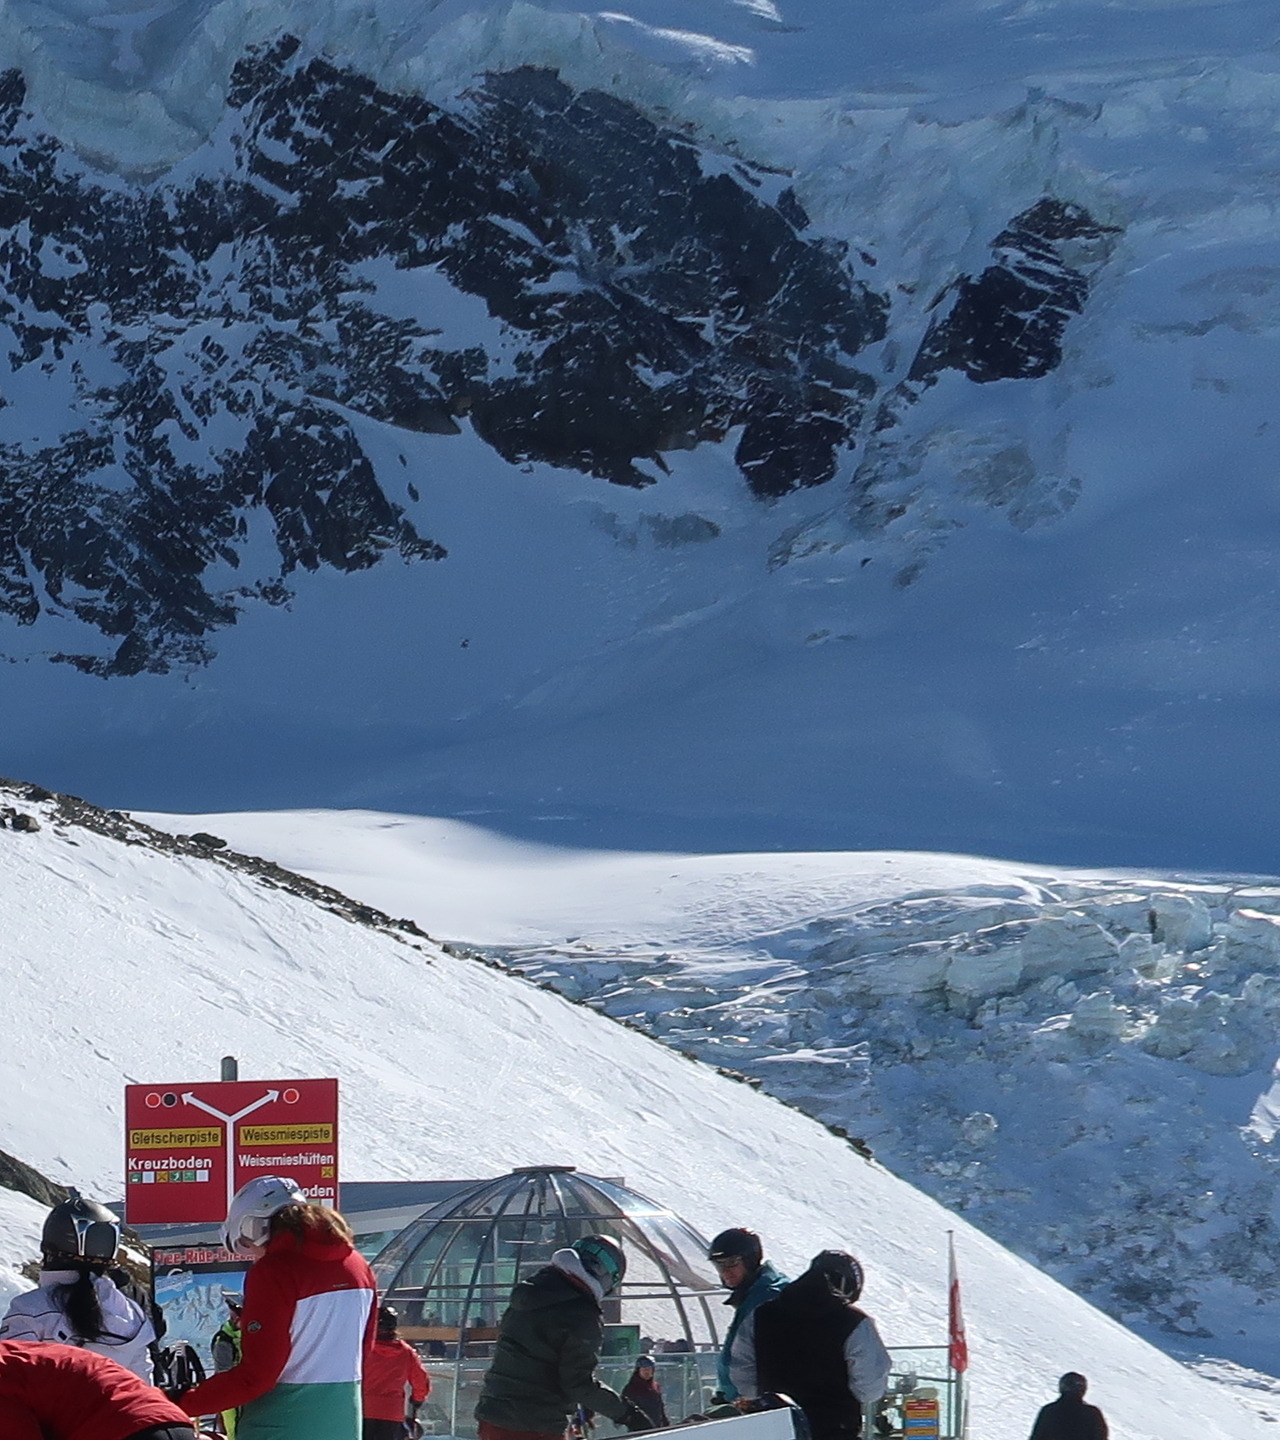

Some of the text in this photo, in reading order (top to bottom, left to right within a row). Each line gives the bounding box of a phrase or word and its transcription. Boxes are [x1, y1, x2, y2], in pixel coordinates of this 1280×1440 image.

[131, 1127, 220, 1147] Gletscherpiste
[242, 1126, 331, 1142] Weissmiespiste
[128, 1155, 213, 1170] Kreuzboden
[238, 1152, 335, 1168] Weissmieshütten
[302, 1184, 335, 1197] oden
